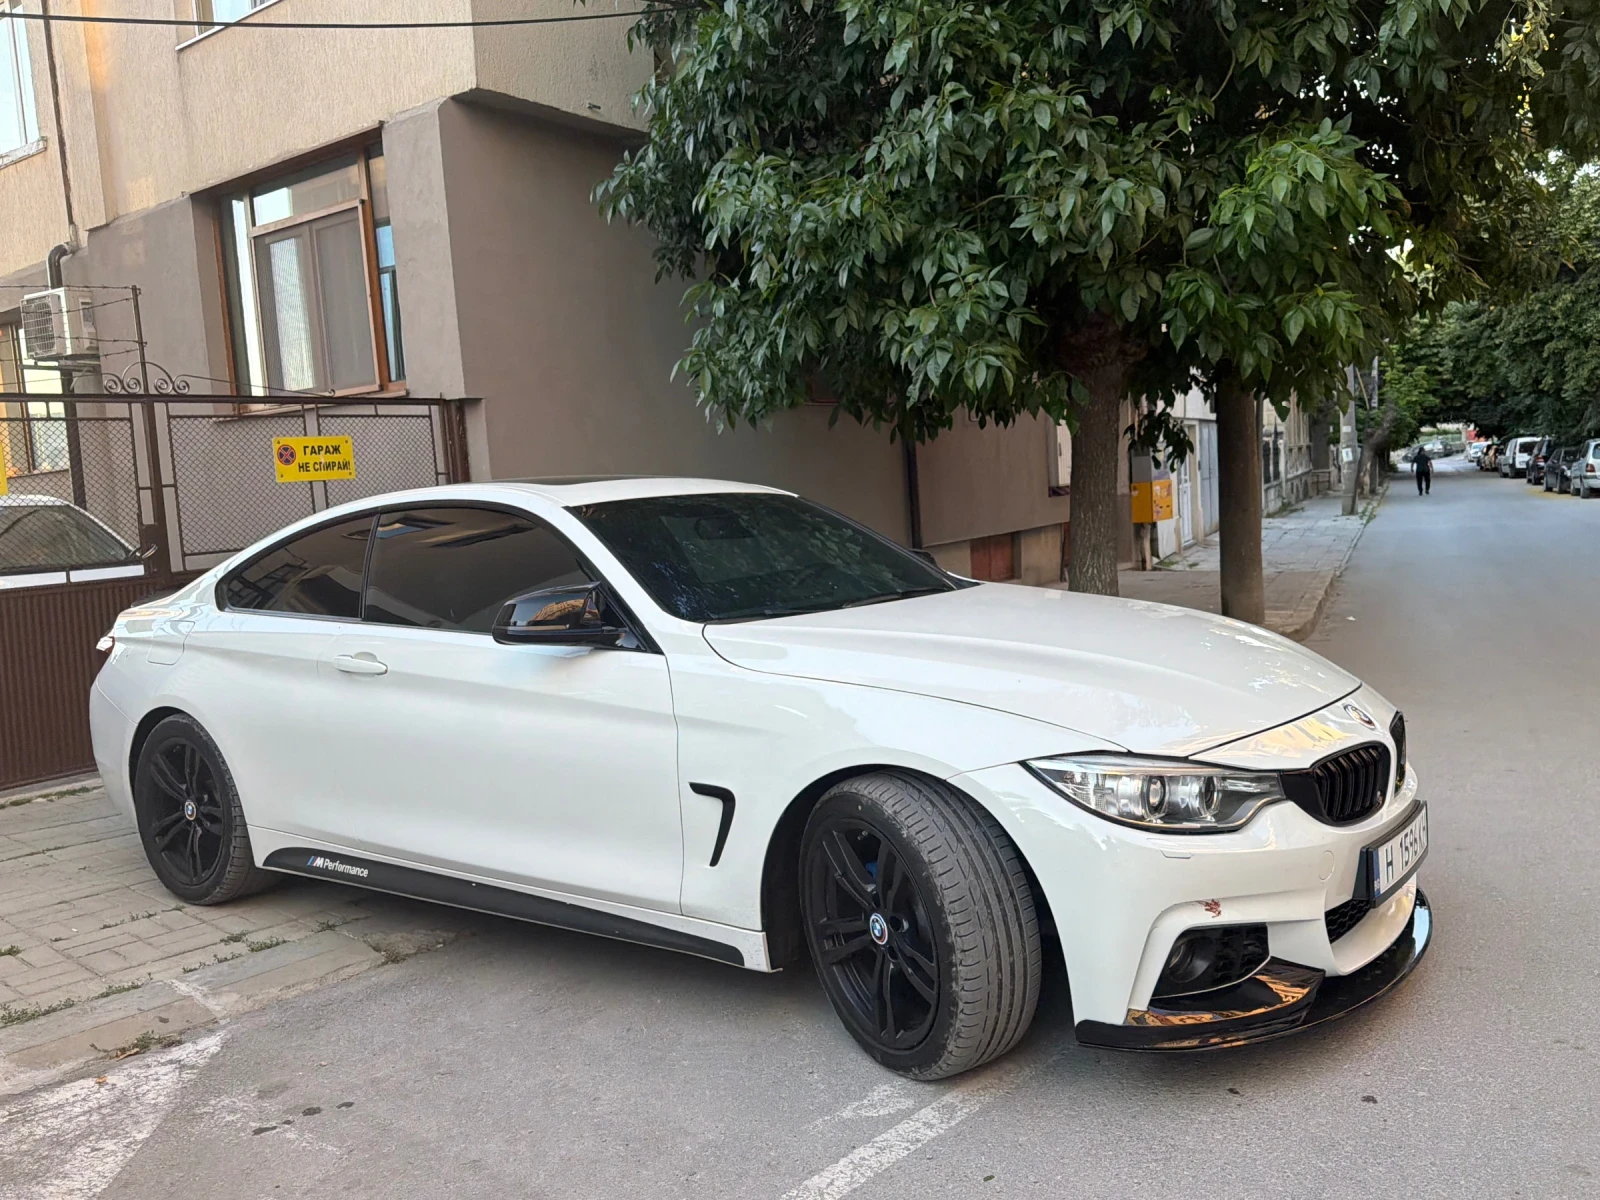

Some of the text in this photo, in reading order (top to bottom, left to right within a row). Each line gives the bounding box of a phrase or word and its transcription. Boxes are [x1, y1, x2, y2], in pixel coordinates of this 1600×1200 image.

[303, 444, 342, 456] ГАРАЖ
[298, 458, 351, 473] НЕ СПИРАЙ!
[1385, 844, 1394, 884] H
[1399, 822, 1418, 870] 1596
[323, 858, 369, 878] Performance
